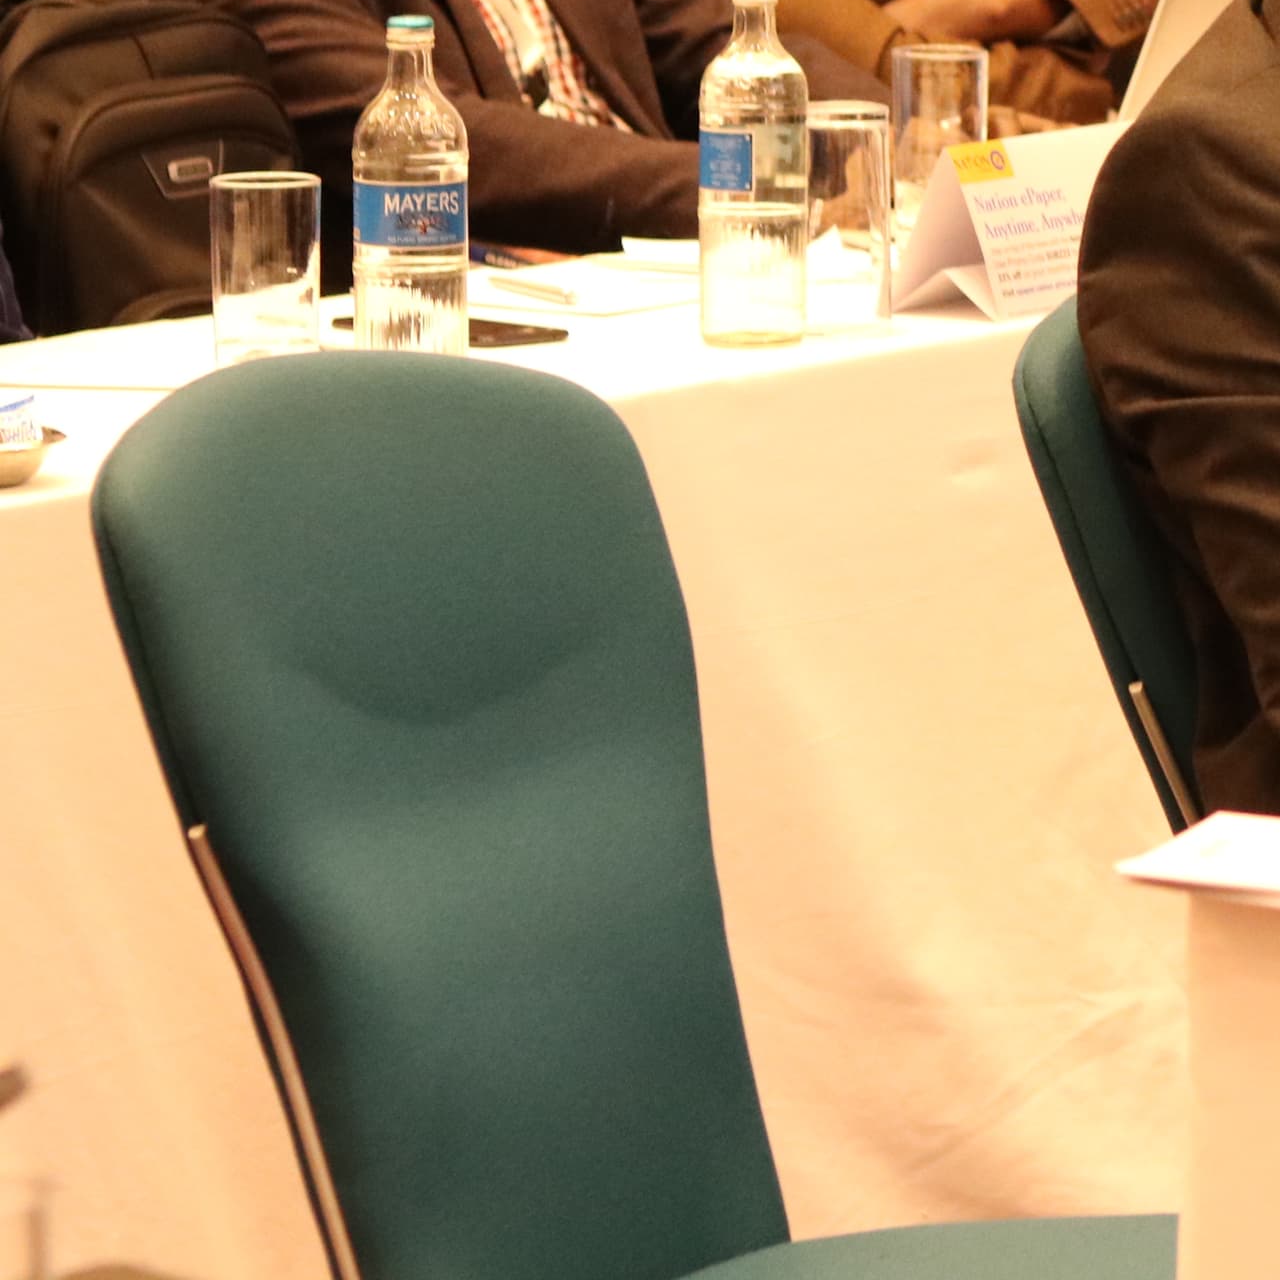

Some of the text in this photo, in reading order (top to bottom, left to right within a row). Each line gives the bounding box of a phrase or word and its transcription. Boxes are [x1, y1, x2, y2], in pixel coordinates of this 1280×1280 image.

[384, 191, 459, 217] MAYERS
[974, 193, 1018, 212] Nation
[984, 218, 1040, 240] Anytime,
